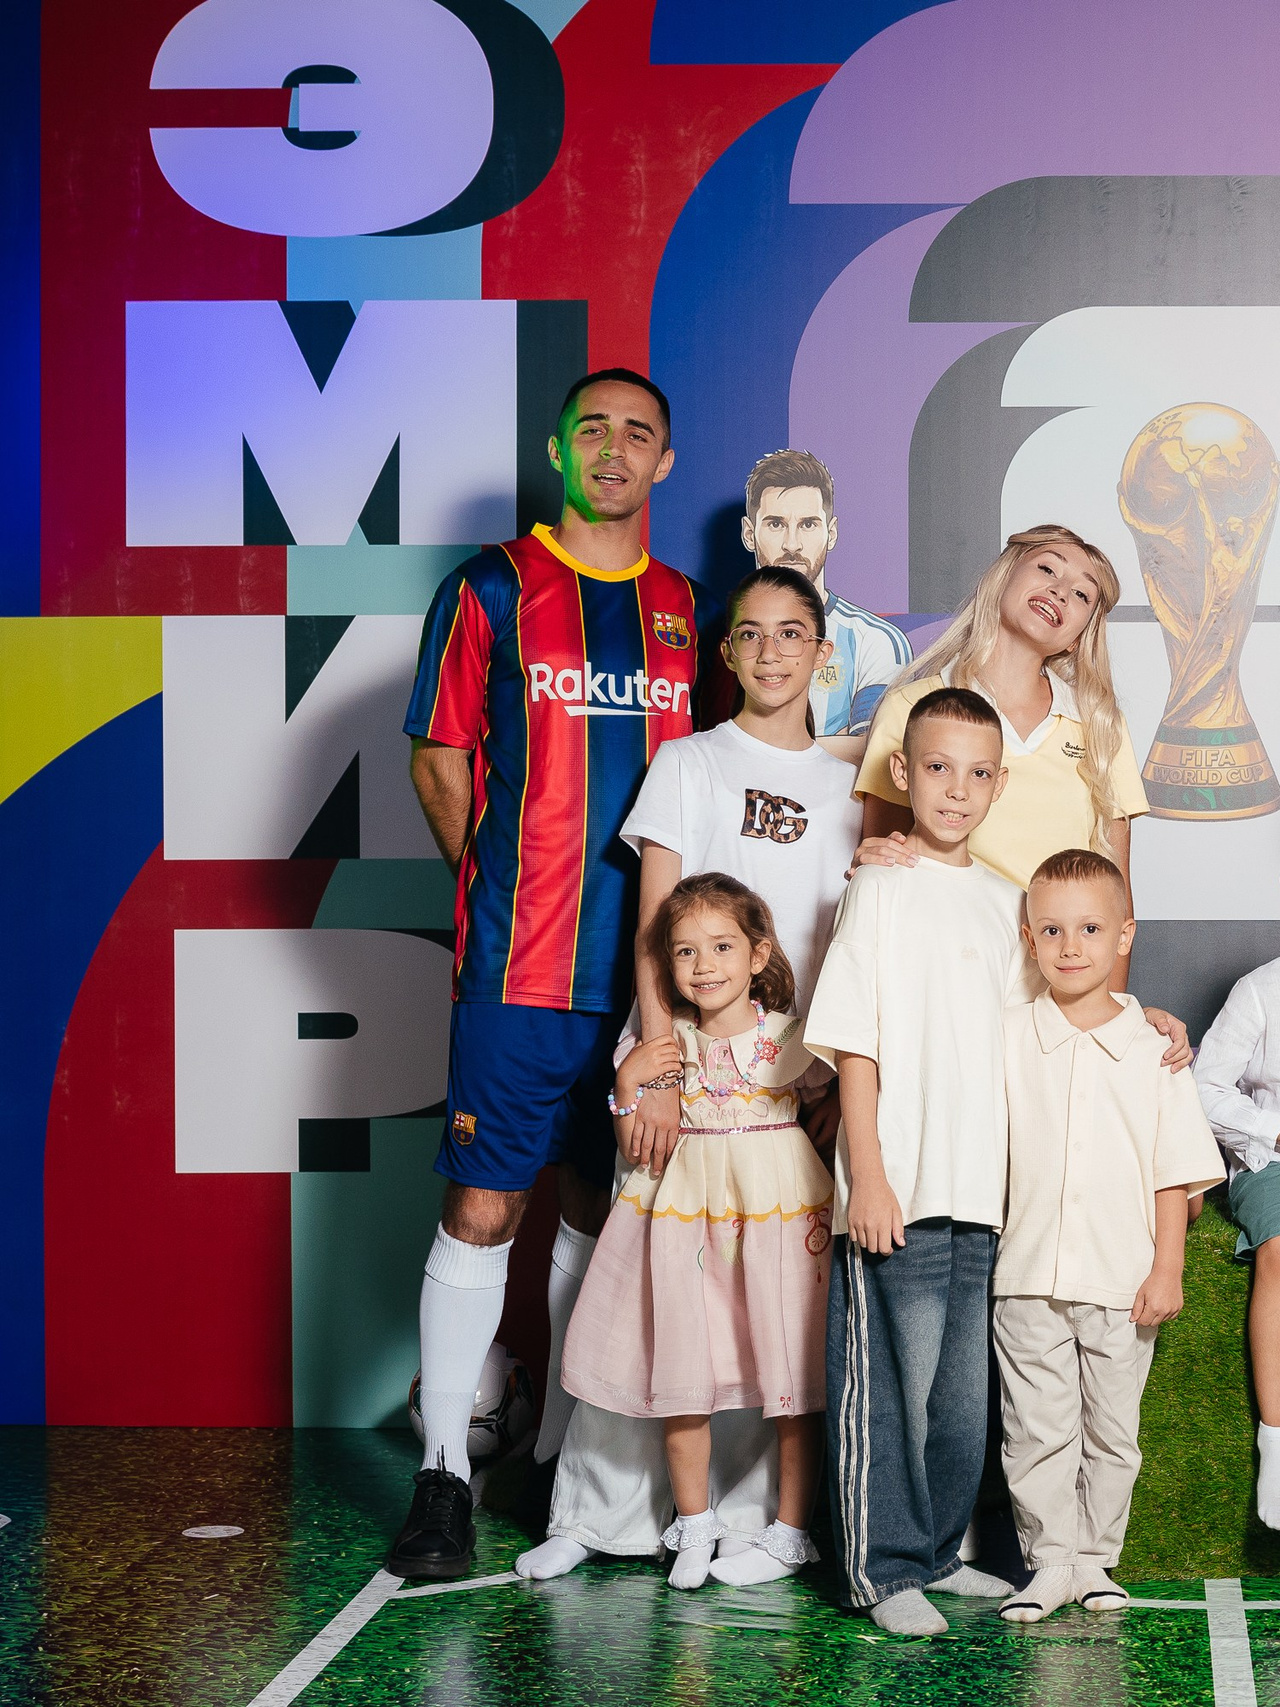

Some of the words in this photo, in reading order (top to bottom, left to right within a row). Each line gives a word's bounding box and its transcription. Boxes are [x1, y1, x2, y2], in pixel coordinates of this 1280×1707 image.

[818, 666, 837, 684] AFA
[528, 662, 691, 716] Rakuten
[1180, 749, 1236, 767] FIFA
[1153, 765, 1223, 786] WORLD
[1226, 764, 1264, 784] CUP
[741, 788, 809, 844] DG
